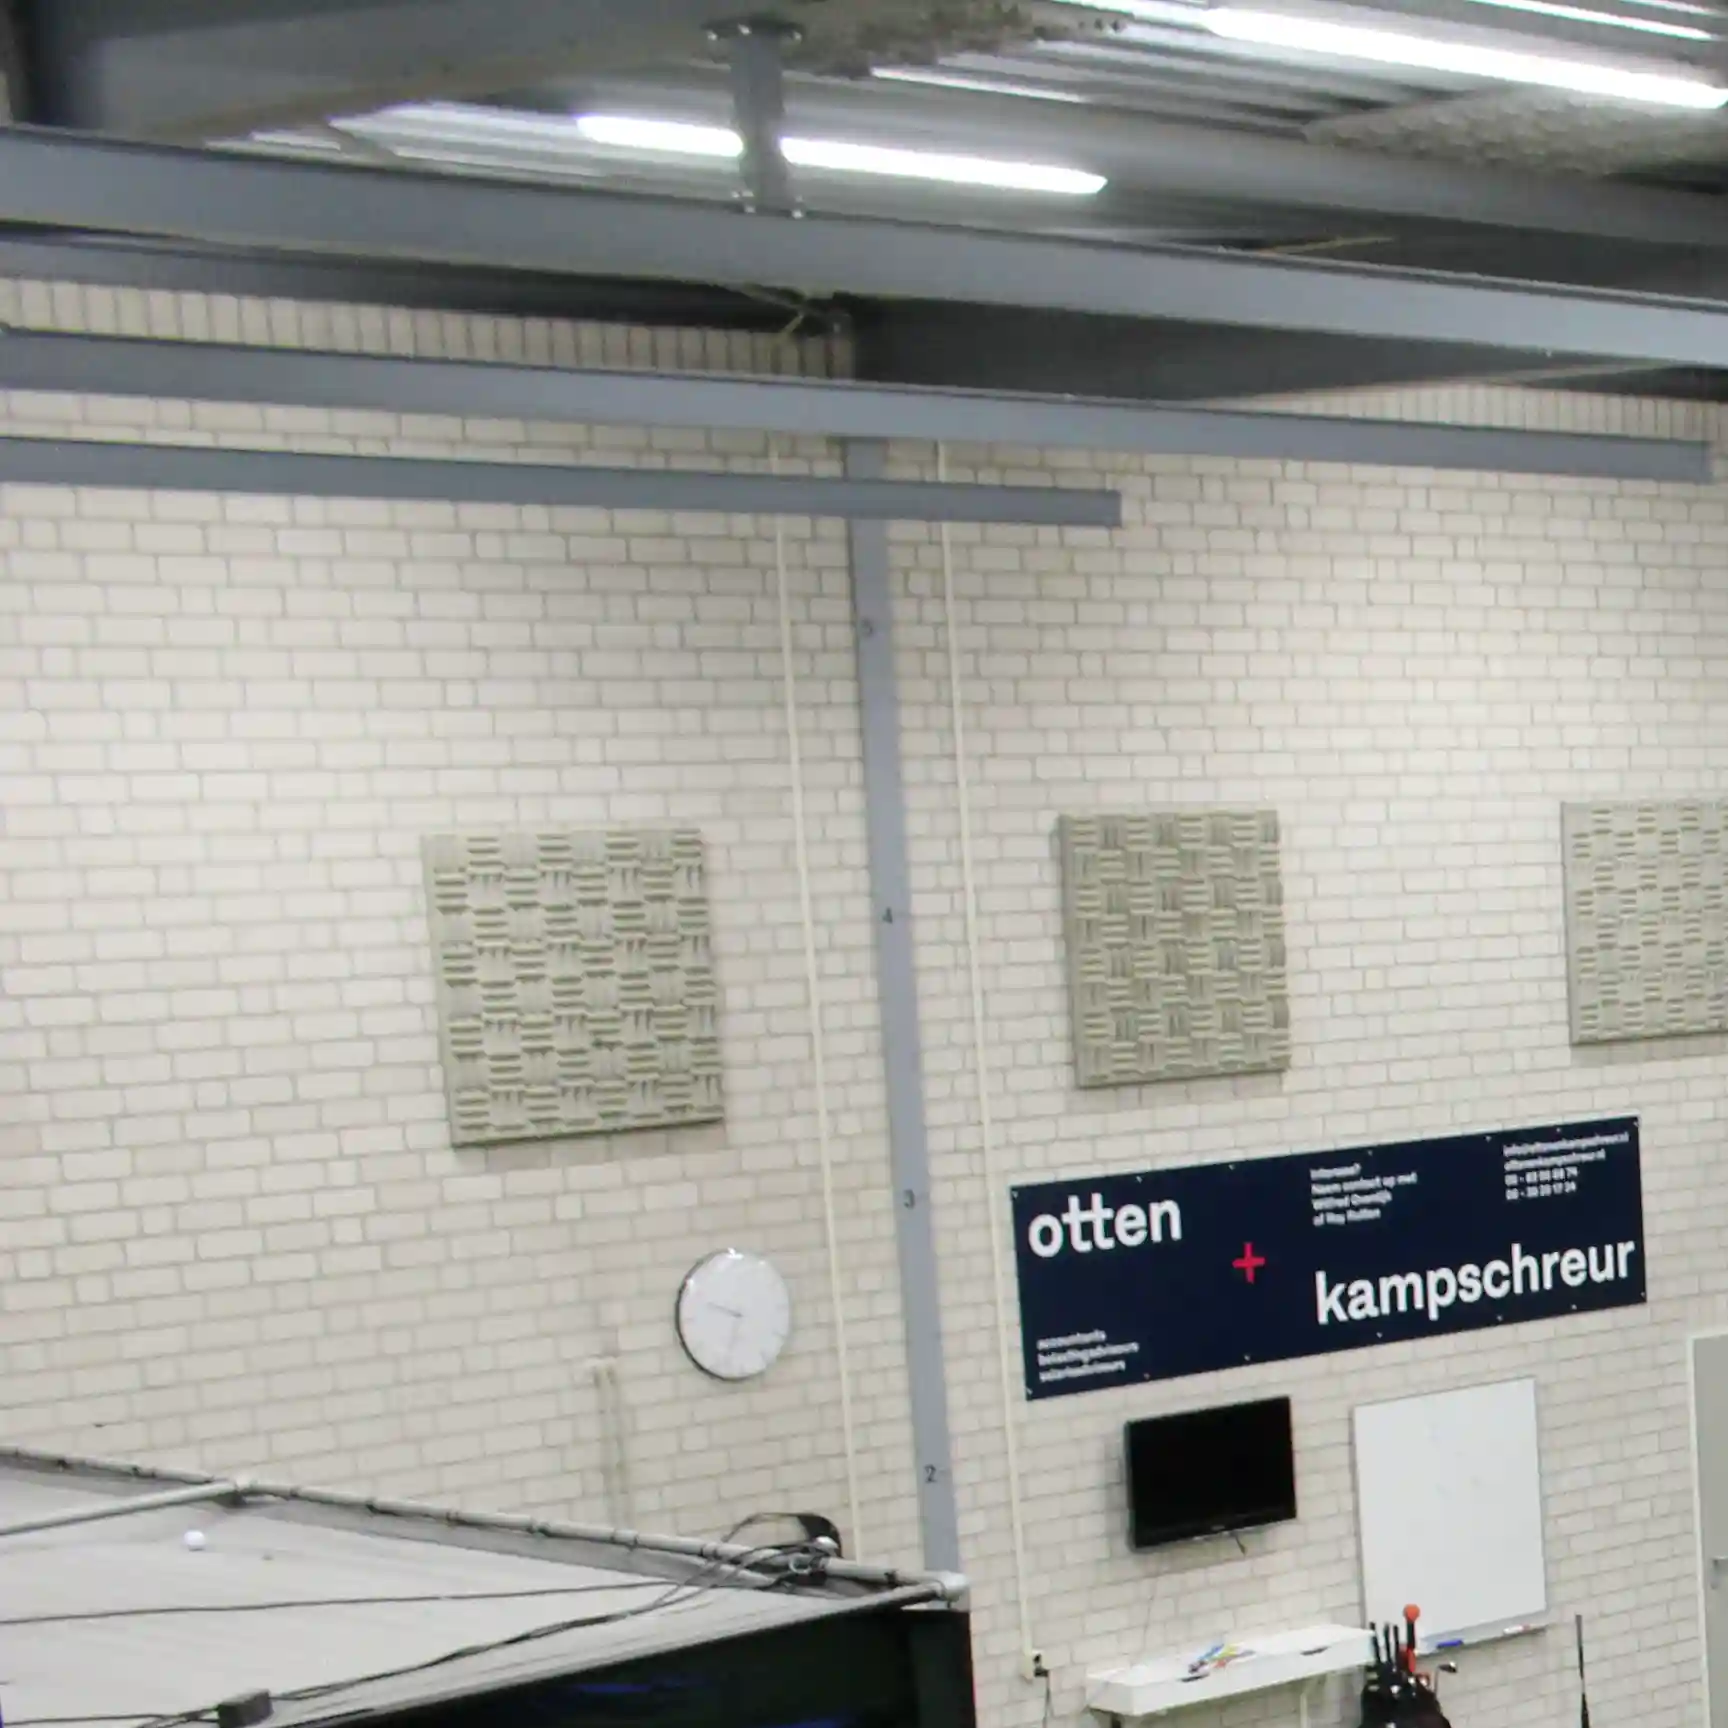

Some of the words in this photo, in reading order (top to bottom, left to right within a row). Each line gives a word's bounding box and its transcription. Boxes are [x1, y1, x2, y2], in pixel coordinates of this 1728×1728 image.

[1028, 1192, 1182, 1258] otten
[1315, 1240, 1636, 1325] kampschreur
[923, 1464, 937, 1485] 2
